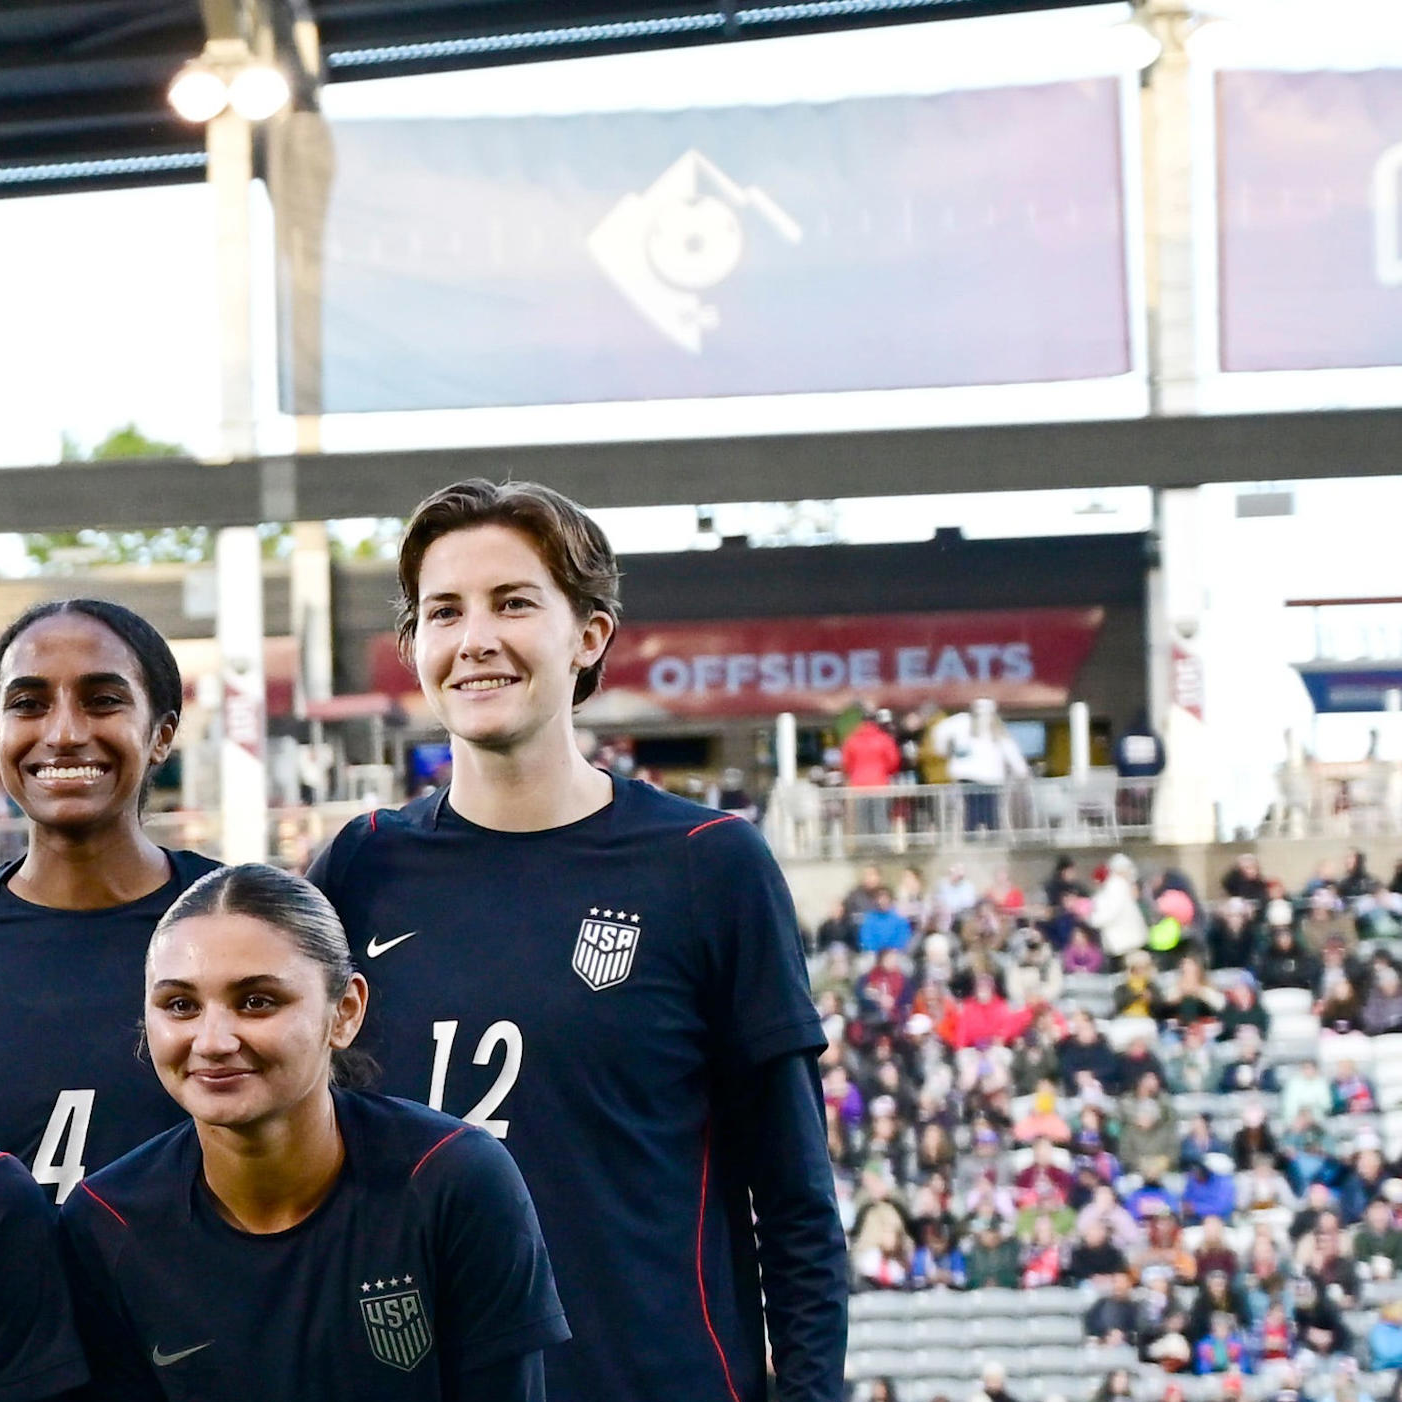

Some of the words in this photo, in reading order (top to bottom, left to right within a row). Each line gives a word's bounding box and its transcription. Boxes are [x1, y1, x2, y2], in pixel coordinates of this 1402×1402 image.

[649, 649, 882, 697] OFFSIDE
[897, 643, 1034, 688] EATS
[584, 923, 635, 952] USA
[428, 1020, 523, 1139] 12
[31, 1089, 96, 1205] 4
[366, 1296, 418, 1328] USA
